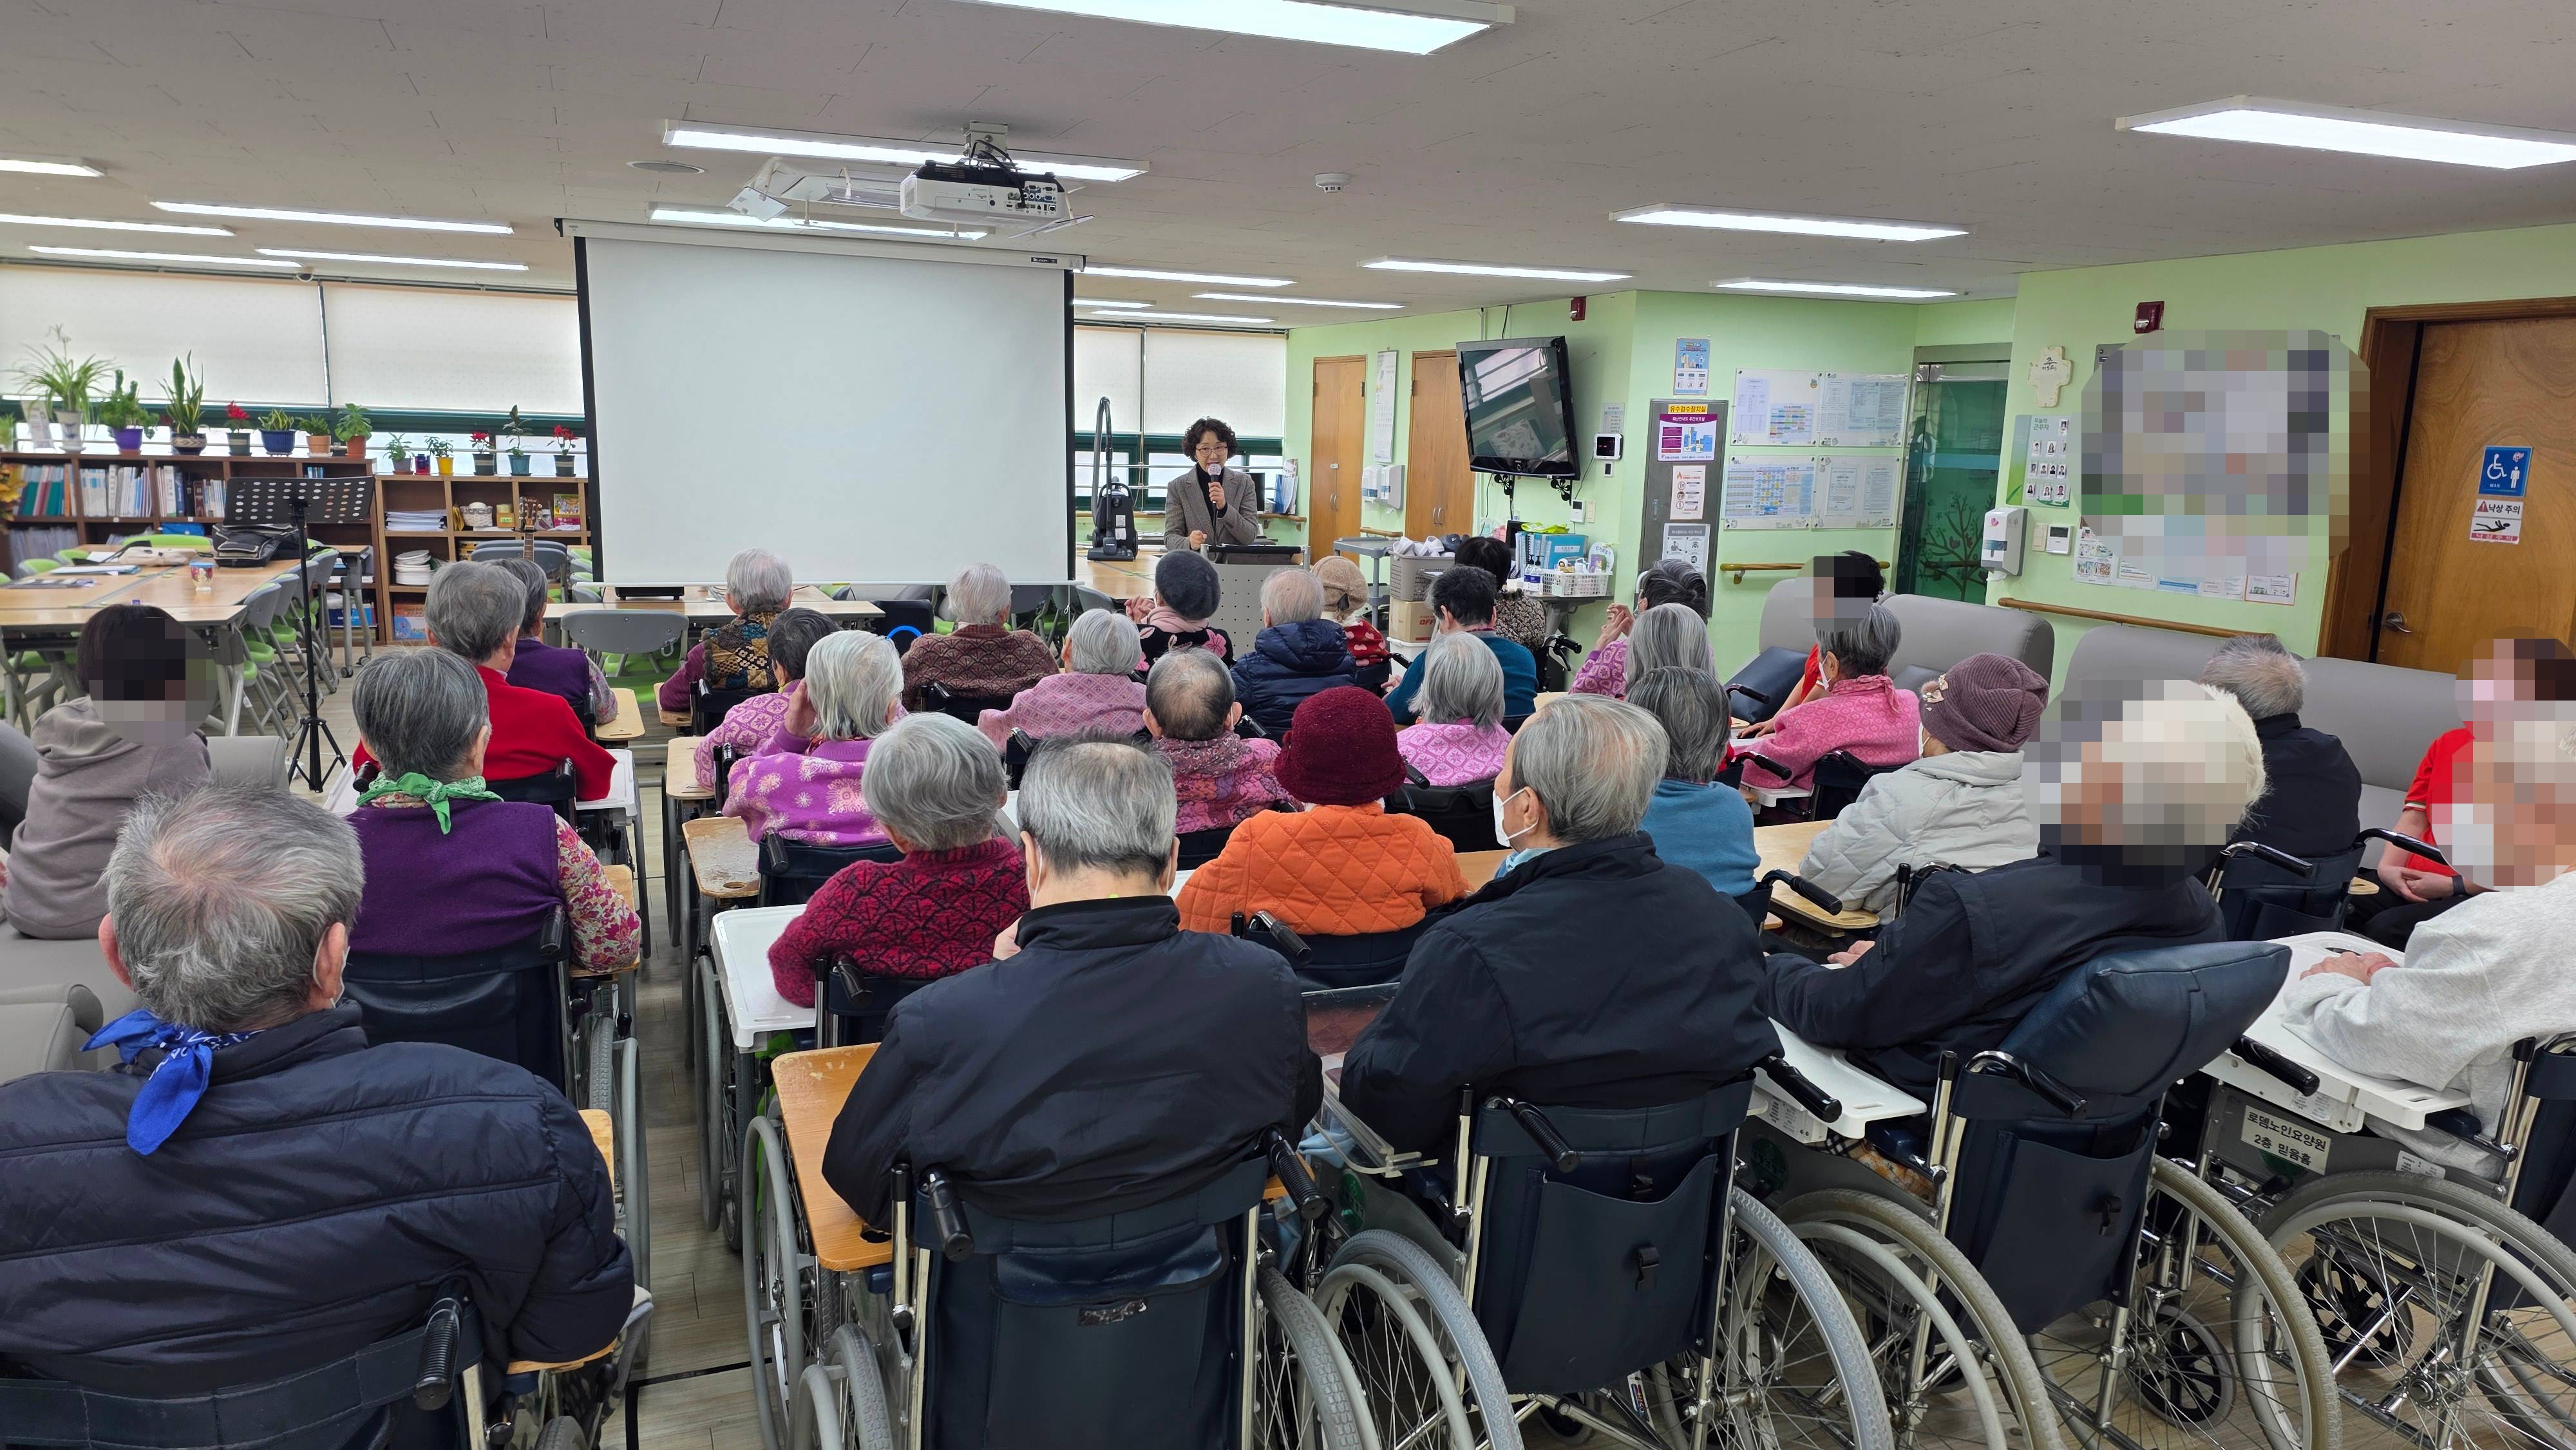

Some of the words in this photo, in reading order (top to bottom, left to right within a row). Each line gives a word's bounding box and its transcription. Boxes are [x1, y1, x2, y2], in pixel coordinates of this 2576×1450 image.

[2488, 504, 2503, 513] 낙상
[2505, 505, 2520, 514] 주의
[2247, 1111, 2326, 1152] 로뎀노인요양원
[2254, 1134, 2272, 1149] 2층
[2278, 1143, 2311, 1166] 믿음홈
